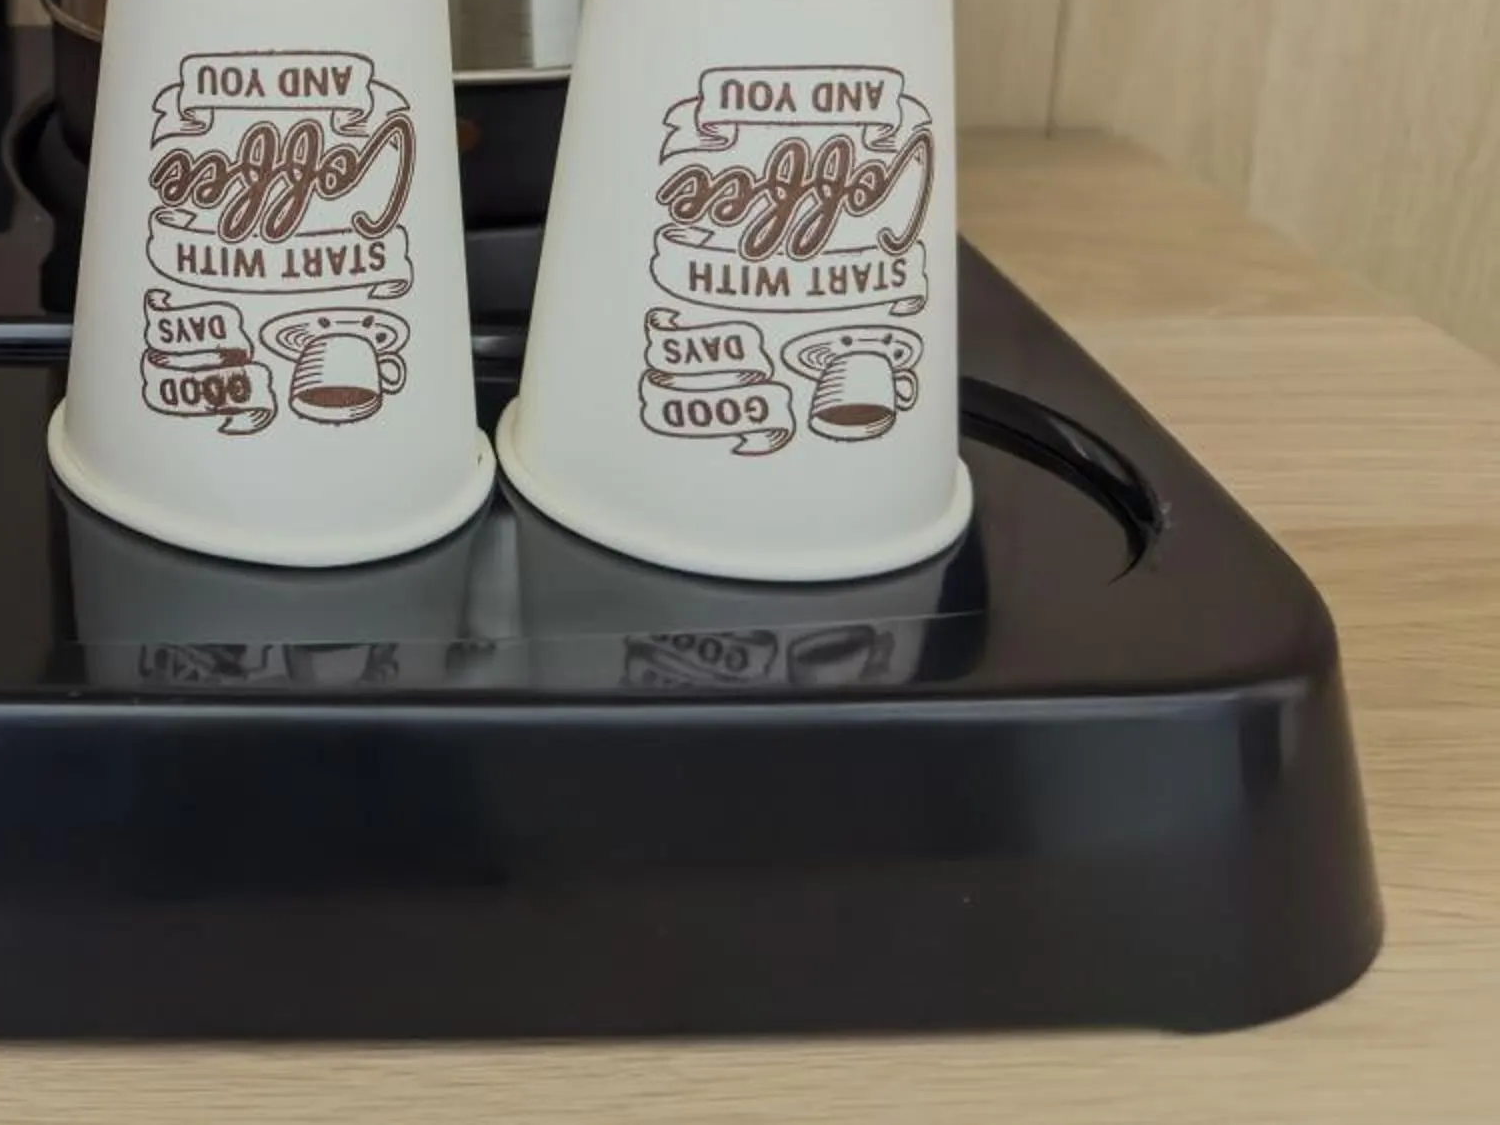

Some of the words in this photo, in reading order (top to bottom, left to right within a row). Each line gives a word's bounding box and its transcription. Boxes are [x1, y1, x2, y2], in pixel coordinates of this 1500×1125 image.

[196, 65, 267, 98] YOU
[279, 65, 354, 98] AND
[718, 78, 798, 113] YOU
[811, 79, 886, 113] AND
[149, 112, 417, 244] Coffee
[655, 128, 936, 262] Coffee
[176, 242, 266, 278] WITH
[280, 241, 387, 279] START
[687, 260, 790, 297] WITH
[805, 259, 908, 297] START
[159, 314, 228, 344] DAYS
[662, 334, 746, 365] DAYS
[158, 369, 254, 408] GOOD
[662, 395, 770, 428] GOOD
